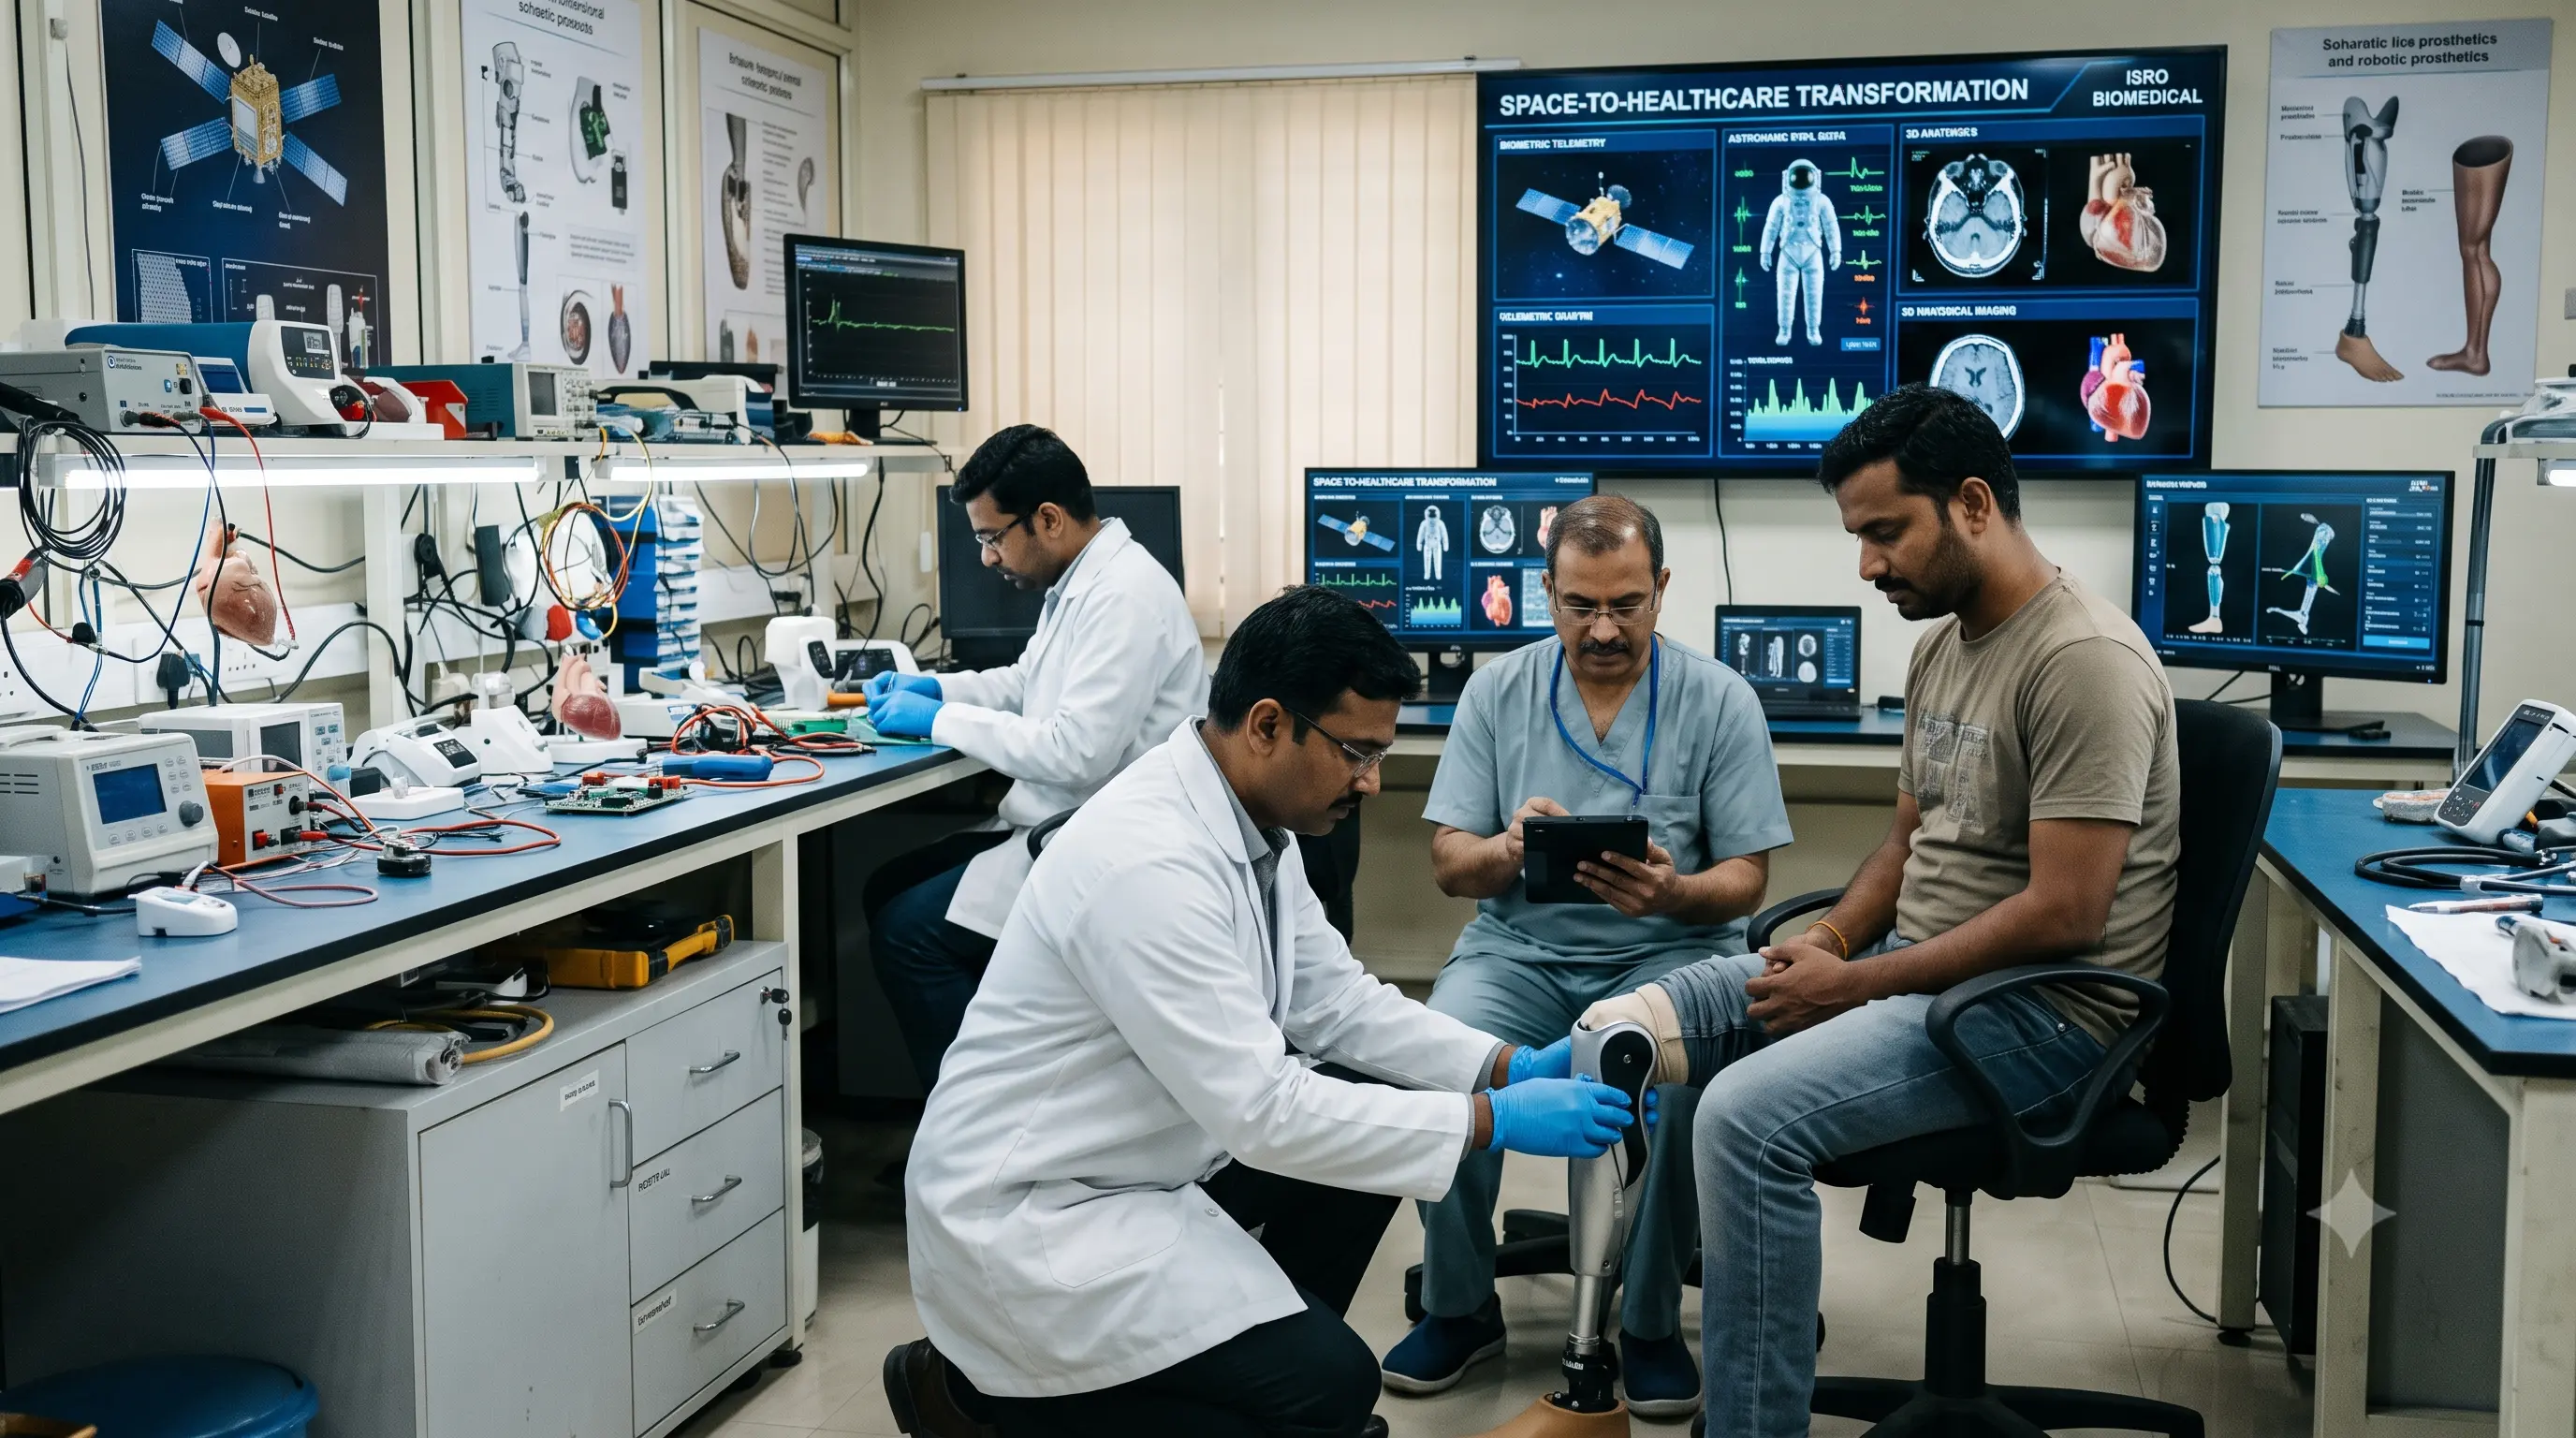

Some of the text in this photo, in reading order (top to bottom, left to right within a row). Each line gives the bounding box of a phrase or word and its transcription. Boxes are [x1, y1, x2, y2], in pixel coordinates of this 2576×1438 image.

[2418, 33, 2497, 49] prosthetics
[2328, 51, 2490, 67] and robotic prosthetics
[2126, 68, 2169, 85] ISRO
[1500, 79, 2028, 116] SPACE-TO-HEALTHCARE TRANSFORMATION
[2092, 88, 2203, 107] BIOMEDICAL
[1313, 477, 1343, 486] SPACE
[1415, 477, 1497, 486] TRANSFORMATION
